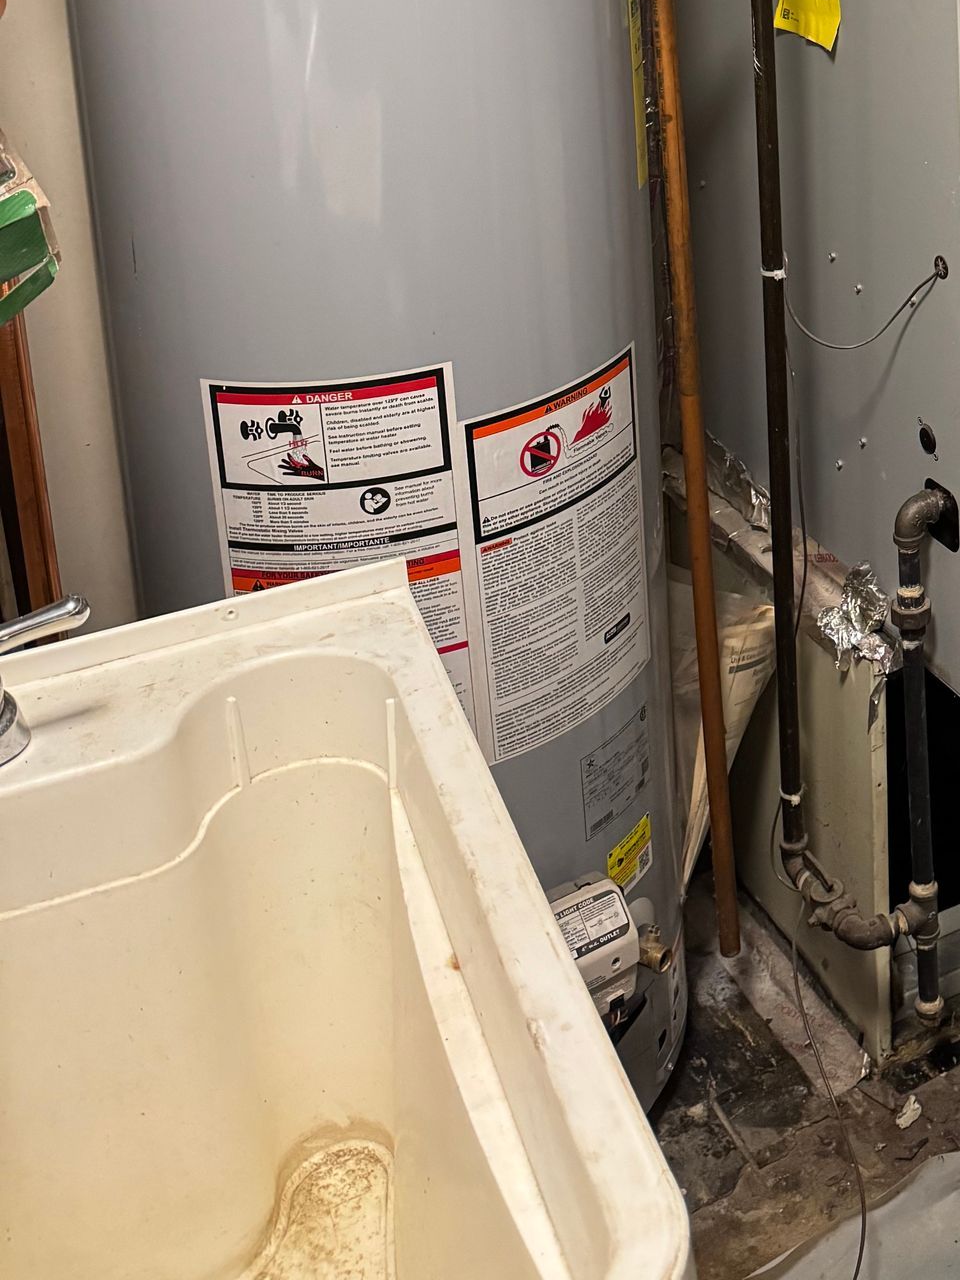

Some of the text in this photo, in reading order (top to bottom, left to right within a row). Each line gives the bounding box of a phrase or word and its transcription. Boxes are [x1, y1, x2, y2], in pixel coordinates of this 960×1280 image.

[306, 392, 353, 404] DANGER
[554, 388, 588, 409] WARNING
[417, 405, 435, 413] highest
[395, 488, 420, 496] information
[395, 494, 420, 502] preventing
[534, 495, 551, 505] gasoline
[514, 515, 529, 523] vicinity
[513, 526, 545, 541] Protect against
[294, 536, 390, 551] IMPORTANT/IMPORTANTE
[560, 898, 594, 917] LIGHT CODE
[600, 930, 620, 942] OUTLET
